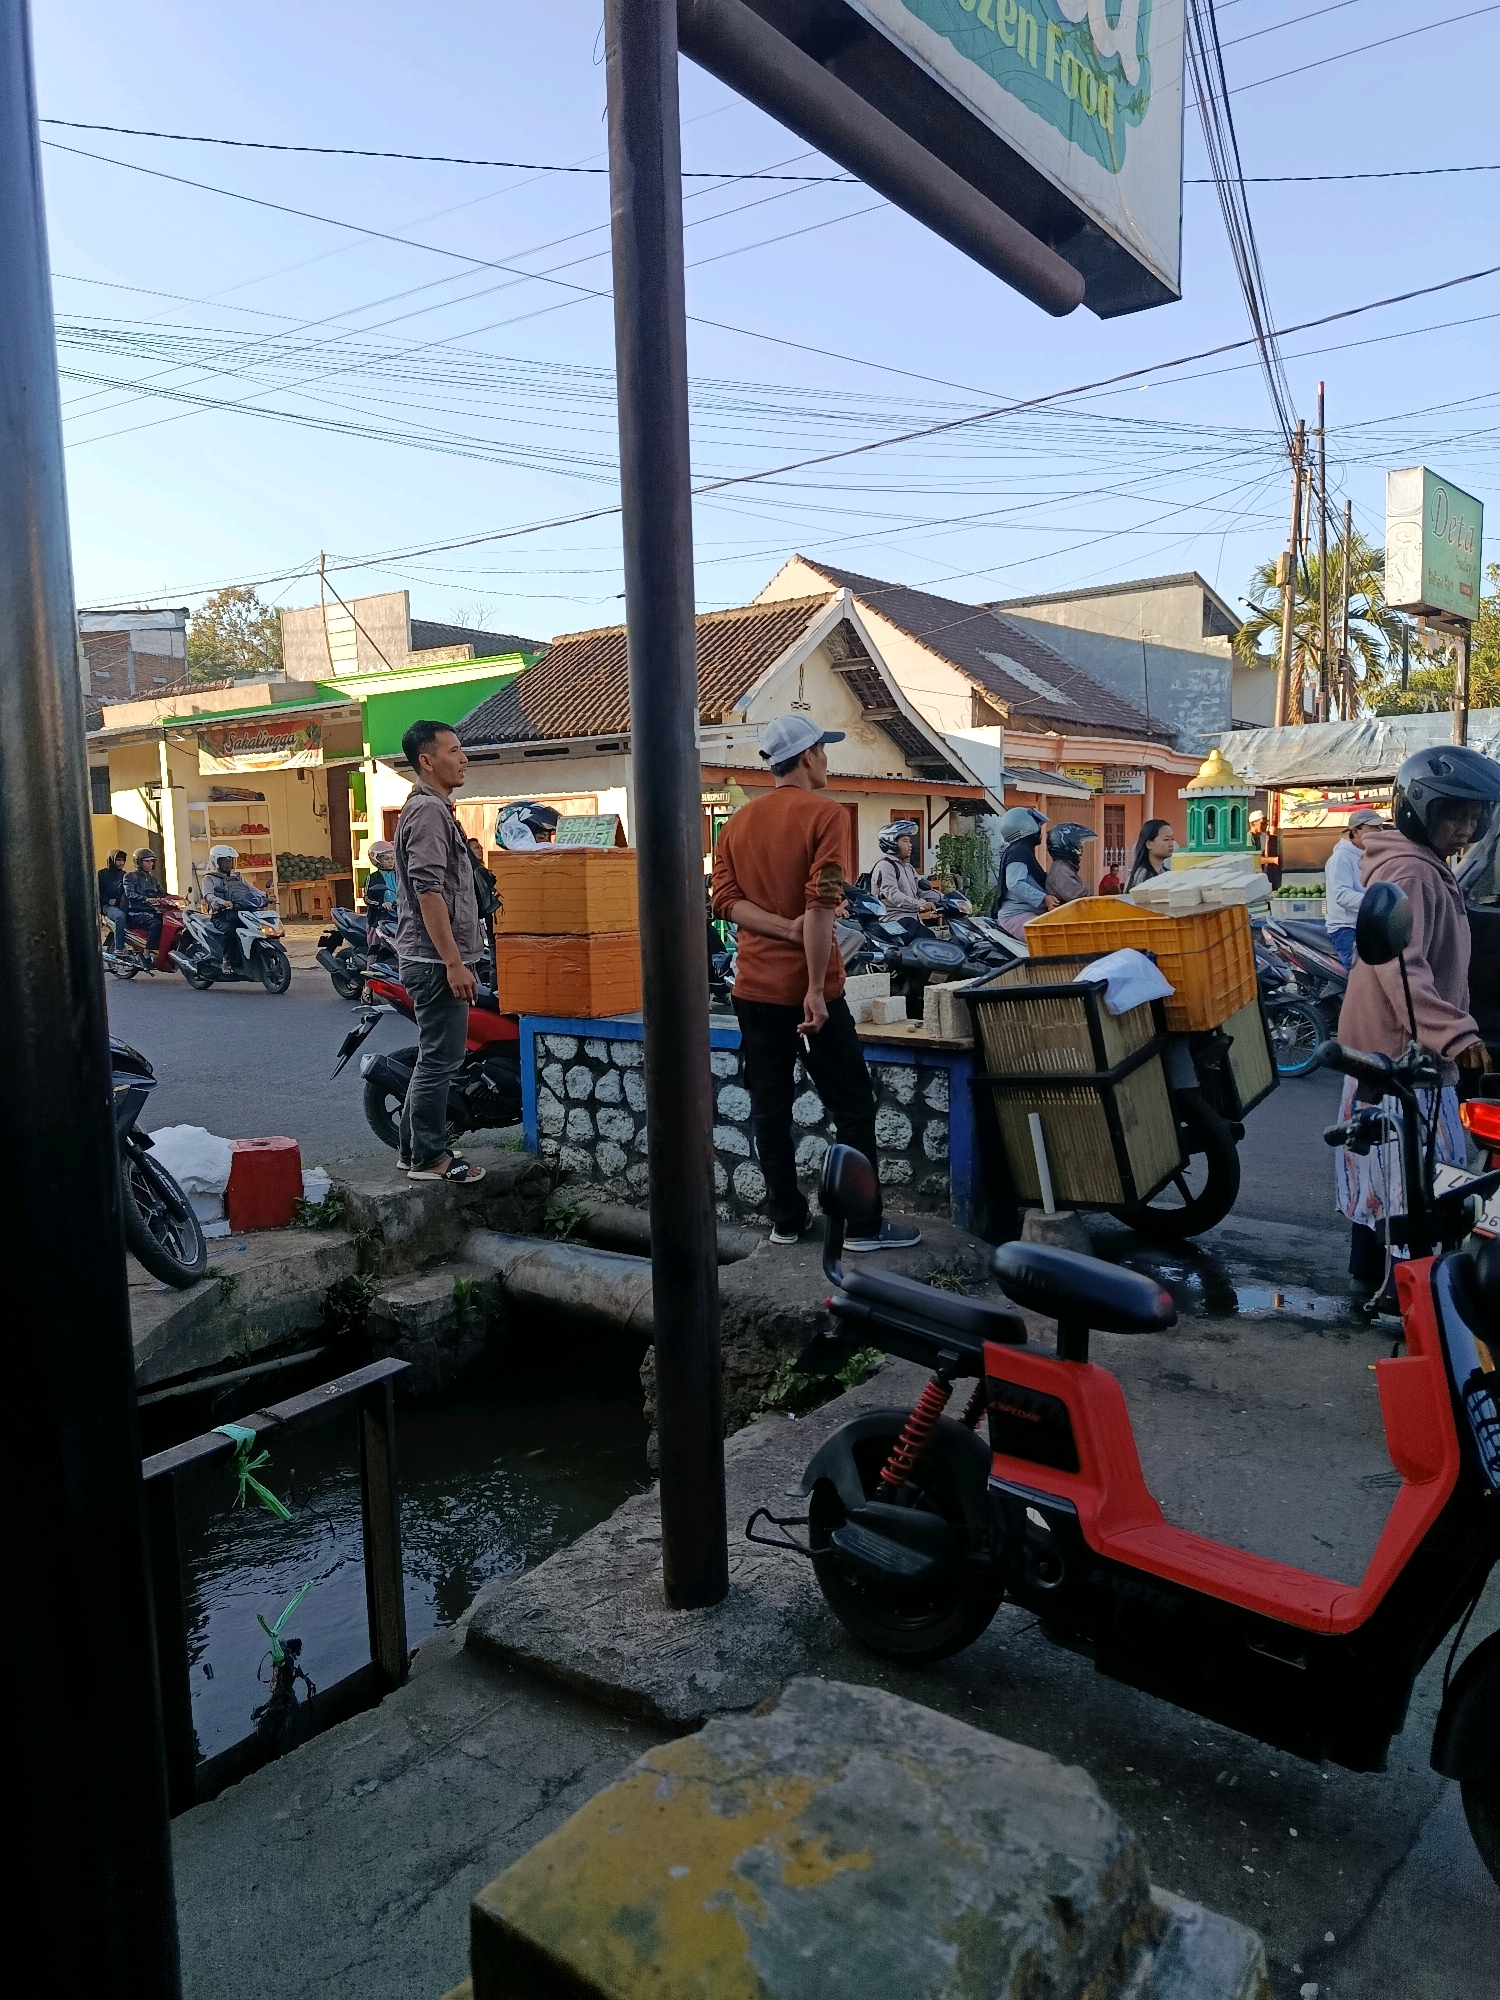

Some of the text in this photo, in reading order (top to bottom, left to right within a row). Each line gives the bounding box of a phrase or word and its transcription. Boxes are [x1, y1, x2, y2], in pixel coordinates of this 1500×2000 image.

[1045, 20, 1115, 135] Food
[1431, 486, 1475, 554] Deta
[224, 730, 297, 753] Sakalingga
[1103, 768, 1142, 777] Canon
